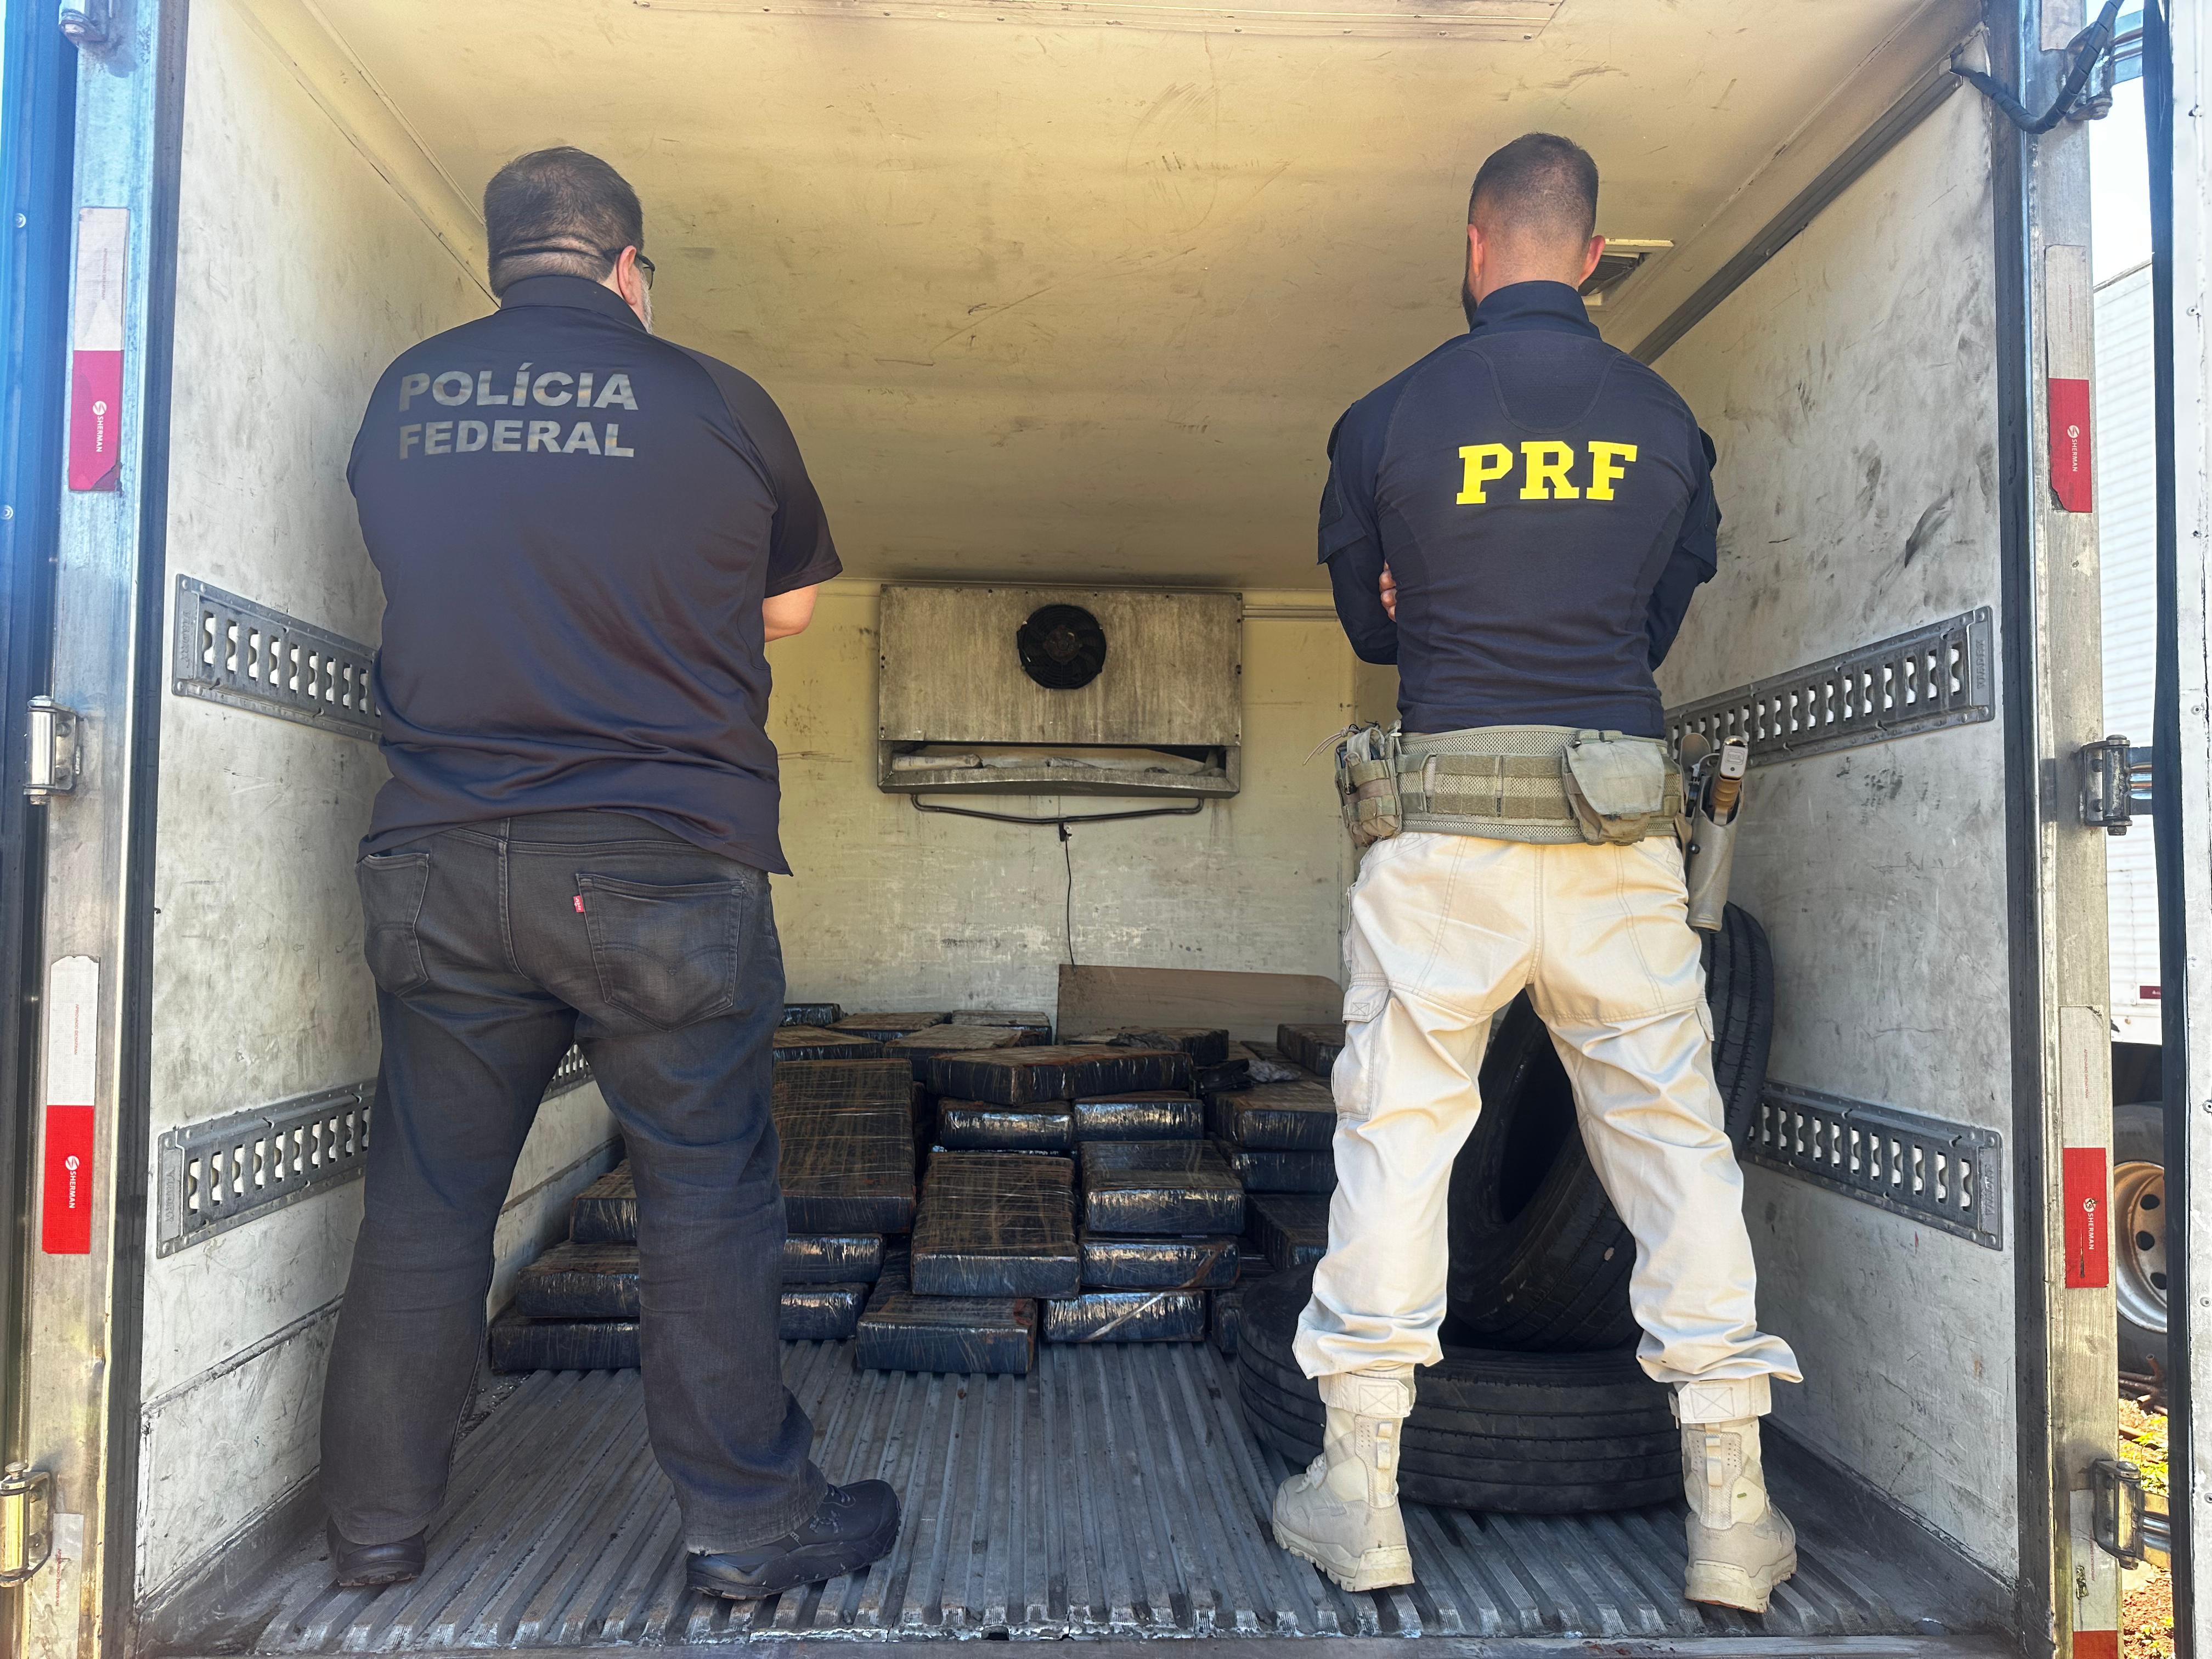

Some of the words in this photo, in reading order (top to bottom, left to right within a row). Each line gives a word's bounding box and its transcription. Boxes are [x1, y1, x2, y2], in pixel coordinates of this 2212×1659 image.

[399, 362, 639, 412] POLÍCIA
[399, 420, 634, 460] FEDERAL
[1456, 441, 1638, 505] PRF
